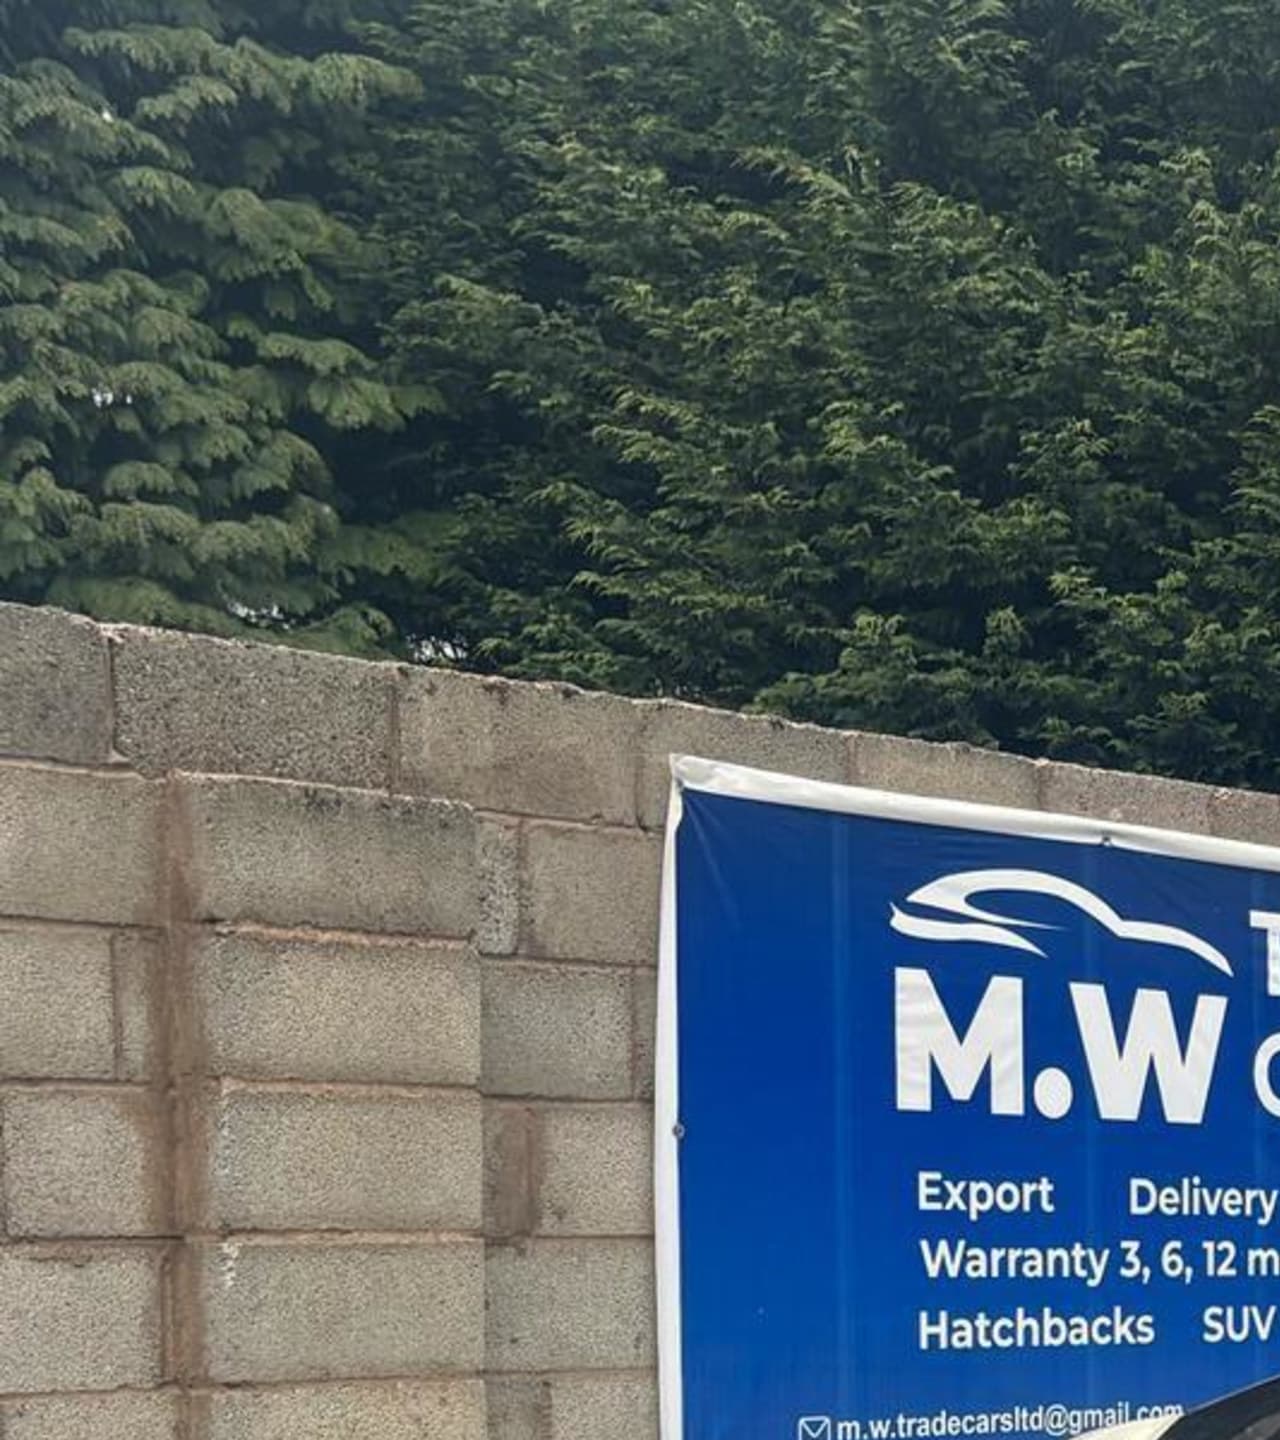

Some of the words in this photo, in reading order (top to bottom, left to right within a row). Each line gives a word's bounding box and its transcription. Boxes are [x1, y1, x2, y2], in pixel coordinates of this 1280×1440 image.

[893, 967, 1230, 1124] M.W
[918, 1171, 1054, 1221] Export
[1130, 1176, 1278, 1225] Delivery
[920, 1239, 1110, 1287] Warranty
[1120, 1240, 1151, 1283] 3,
[1161, 1240, 1193, 1283] 6,
[1202, 1240, 1237, 1276] 12
[919, 1306, 1155, 1349] Hatchbacks
[1204, 1305, 1276, 1342] SUV
